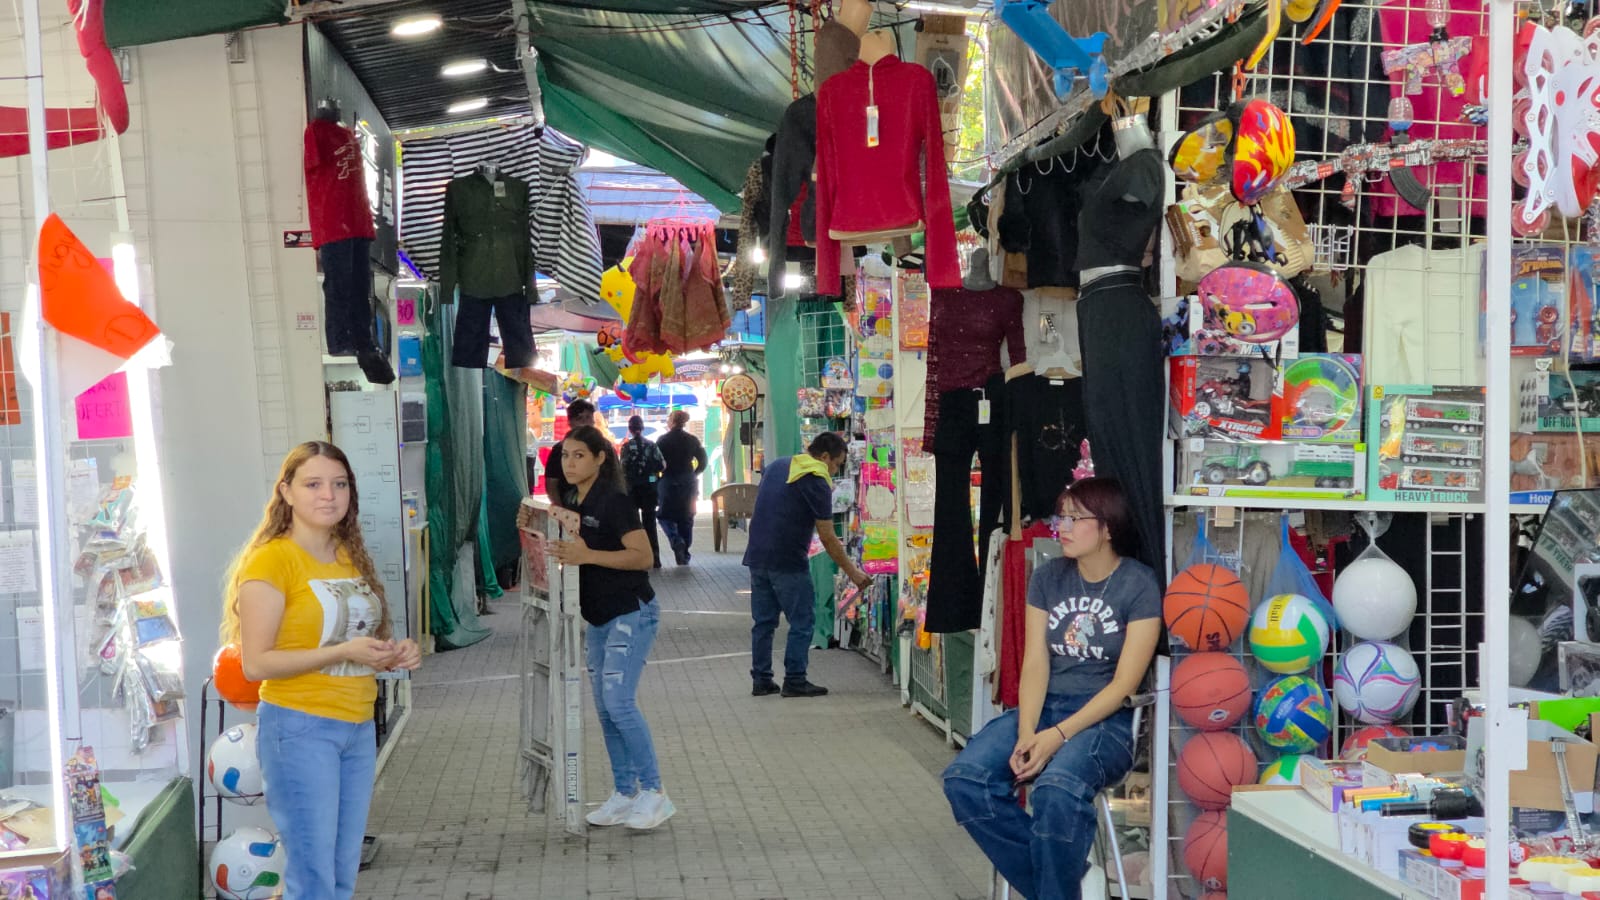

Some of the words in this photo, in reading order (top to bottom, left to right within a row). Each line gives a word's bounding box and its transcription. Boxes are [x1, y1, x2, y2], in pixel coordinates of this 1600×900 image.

[77, 400, 122, 420] OFERT
[1394, 491, 1430, 502] HEAVY
[1433, 492, 1469, 503] TRUCK
[567, 756, 577, 800] TOOLCRAFT
